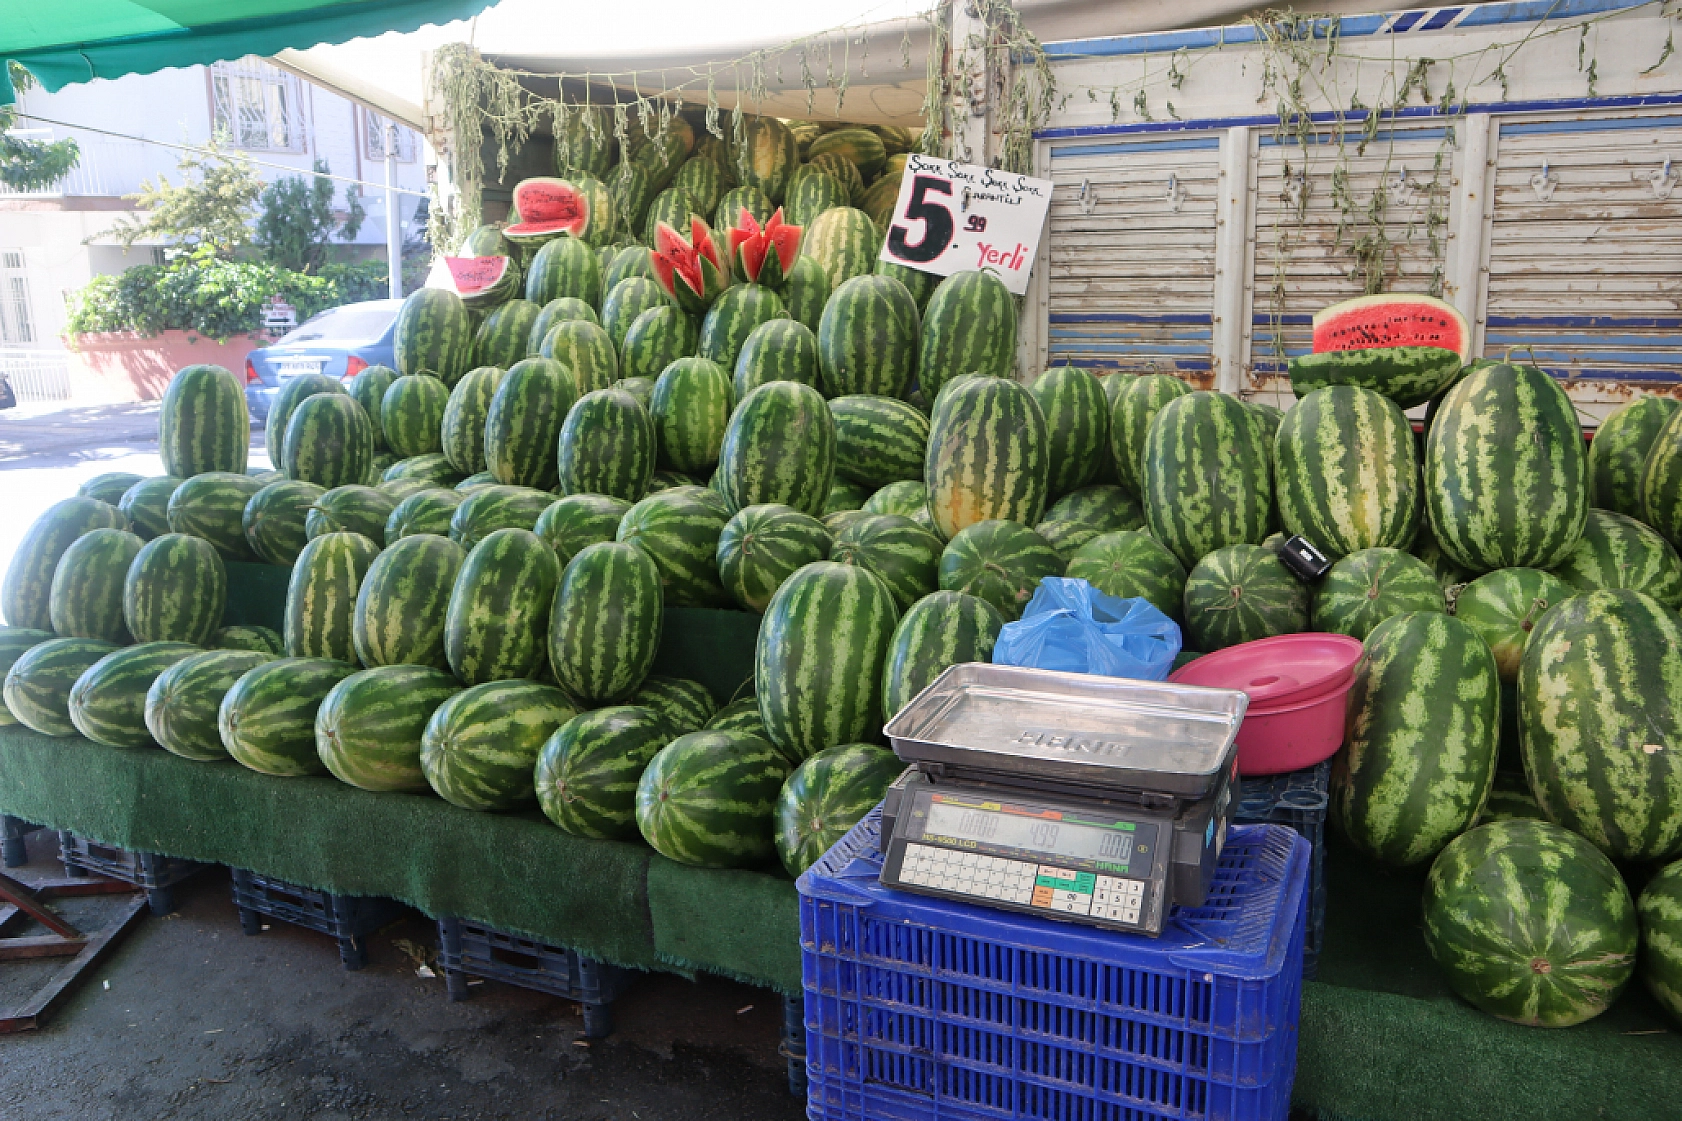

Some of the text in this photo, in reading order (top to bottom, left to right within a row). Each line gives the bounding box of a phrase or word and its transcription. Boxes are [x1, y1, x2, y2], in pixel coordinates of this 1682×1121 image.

[976, 241, 1029, 271] Yerli
[959, 839, 978, 849] LCD
[1096, 860, 1129, 873] HANA
